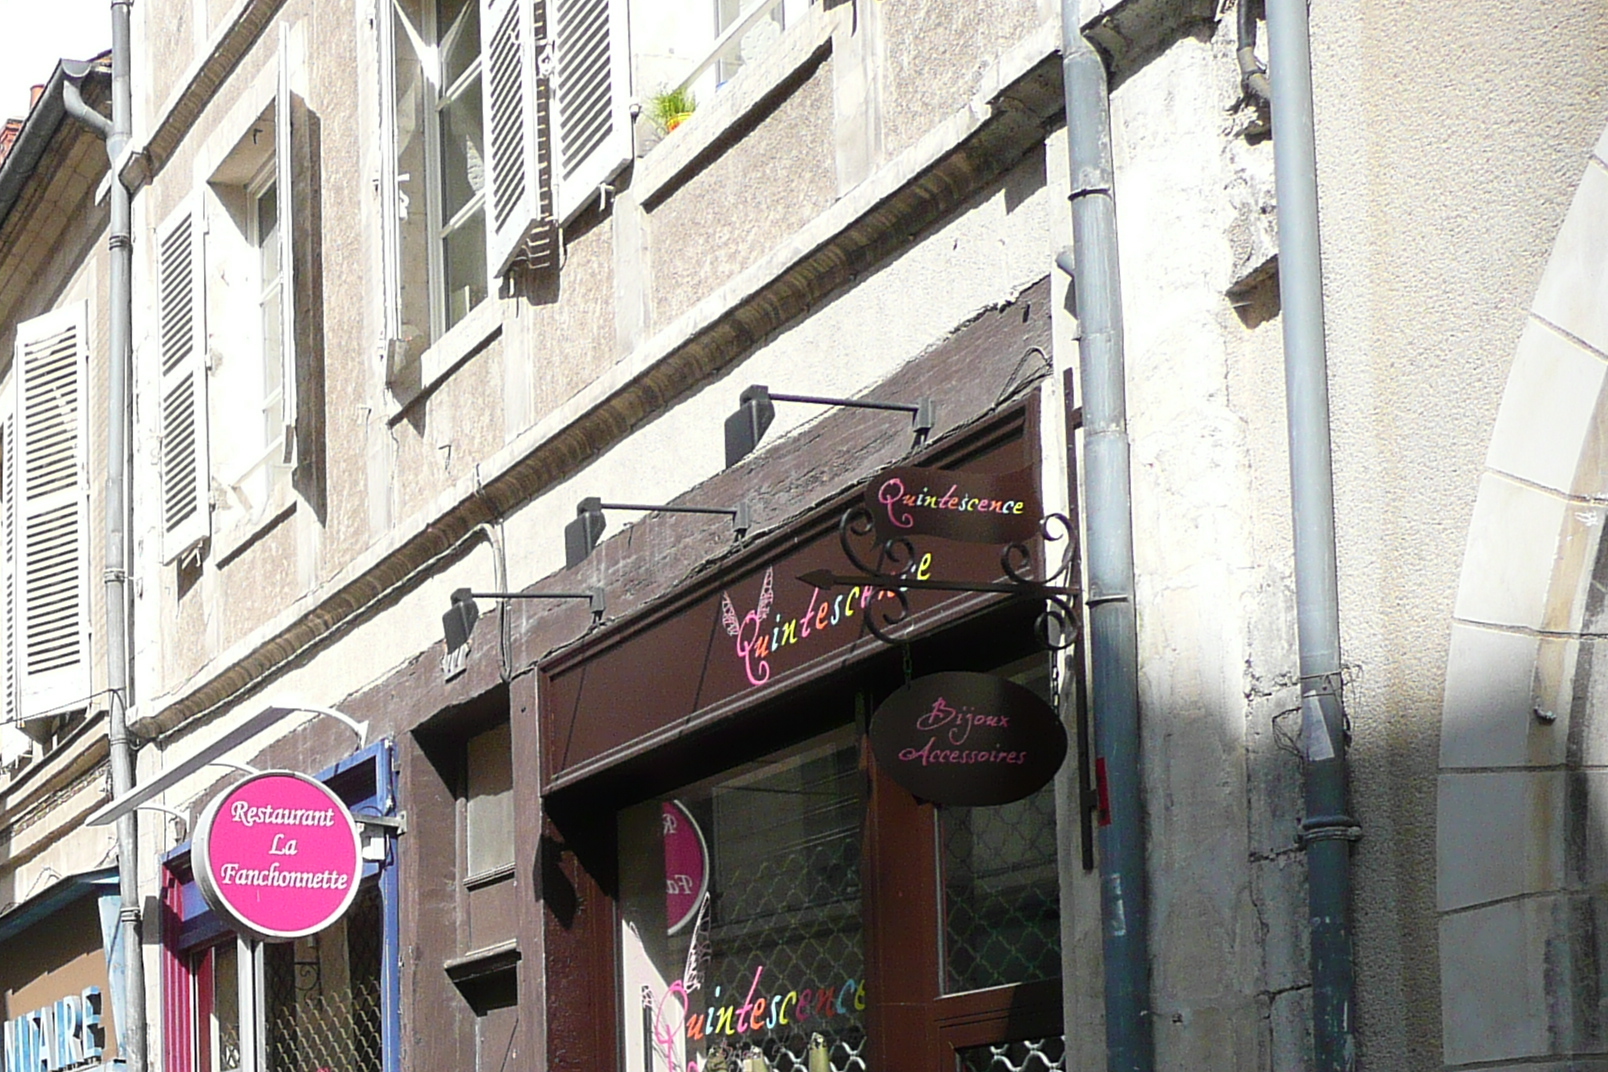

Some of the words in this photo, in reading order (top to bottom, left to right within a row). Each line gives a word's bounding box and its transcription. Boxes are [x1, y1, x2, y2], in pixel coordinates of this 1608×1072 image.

[878, 478, 1024, 528] Quintescence
[917, 697, 1010, 745] Bijoux
[898, 737, 1027, 766] Accessoires
[231, 800, 335, 827] Restaurant
[268, 833, 298, 856] La
[220, 862, 348, 890] Fanchonnette
